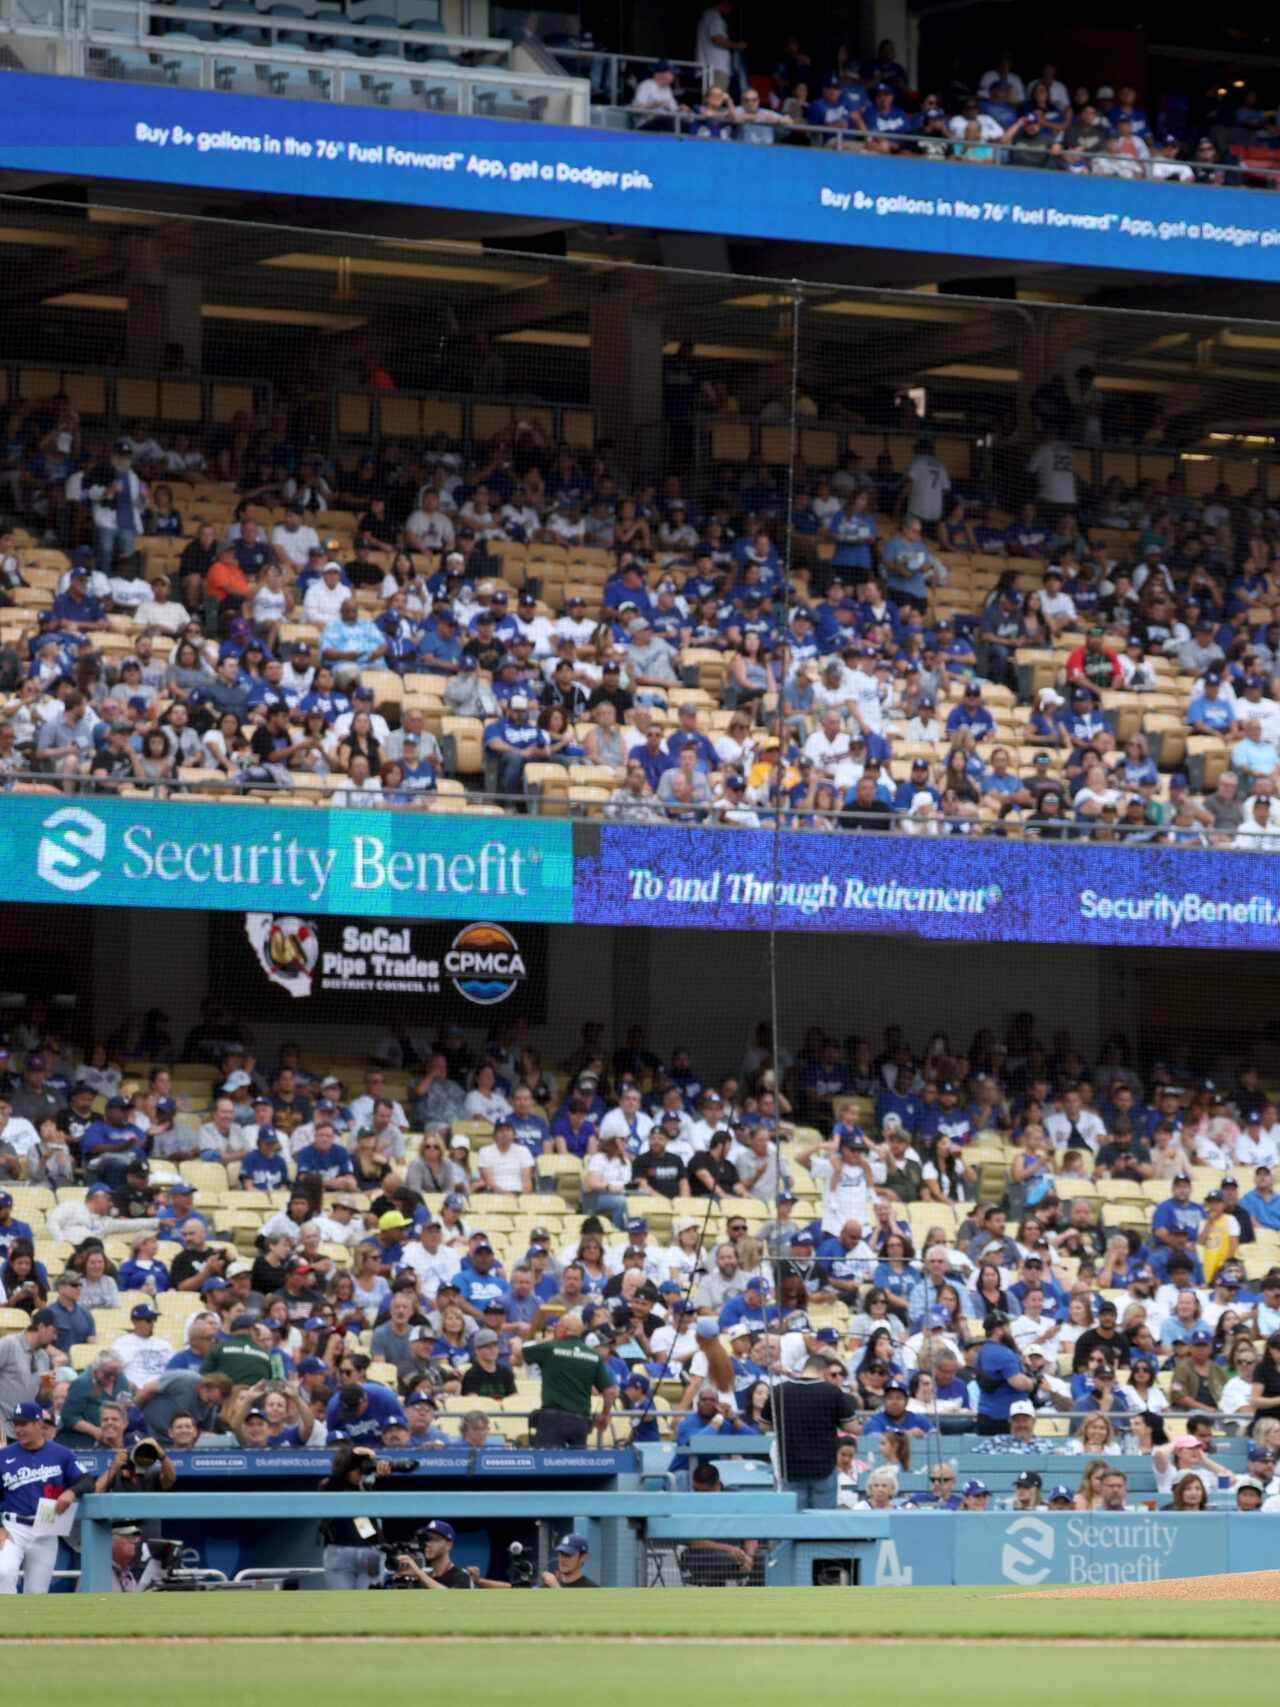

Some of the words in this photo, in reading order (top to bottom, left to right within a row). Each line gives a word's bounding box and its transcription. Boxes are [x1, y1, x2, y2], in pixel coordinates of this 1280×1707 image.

[136, 122, 168, 146] Buy
[172, 125, 193, 145] 8+
[198, 130, 261, 153] gallons
[264, 134, 280, 154] in
[284, 137, 312, 157] the
[348, 142, 382, 163] Fuel
[466, 154, 507, 178] App,
[509, 160, 538, 181] get
[540, 164, 553, 180] a
[556, 162, 618, 189] Dodger
[621, 170, 653, 191] pin.
[821, 187, 850, 210] Buy
[876, 195, 934, 216] gallons
[937, 200, 951, 216] in
[954, 201, 980, 220] the
[1012, 205, 1043, 225] Fuel
[1159, 221, 1186, 240] get
[1188, 225, 1200, 238] a
[1202, 223, 1259, 246] Dodger
[123, 824, 337, 901] Security
[628, 868, 662, 901] To
[667, 871, 720, 903] and
[725, 872, 839, 915] Through
[342, 925, 411, 954] SoCal
[322, 952, 367, 979] Pipe
[370, 953, 440, 978] Trades
[444, 950, 527, 975] CPMCA
[1, 1471, 18, 1487] Los
[17, 1464, 64, 1485] Dodgers
[255, 1456, 332, 1468] blueshieldca.com
[543, 1456, 615, 1467] blueshieldca.com
[1067, 1517, 1179, 1556] Security
[1068, 1553, 1164, 1584] Benefit
